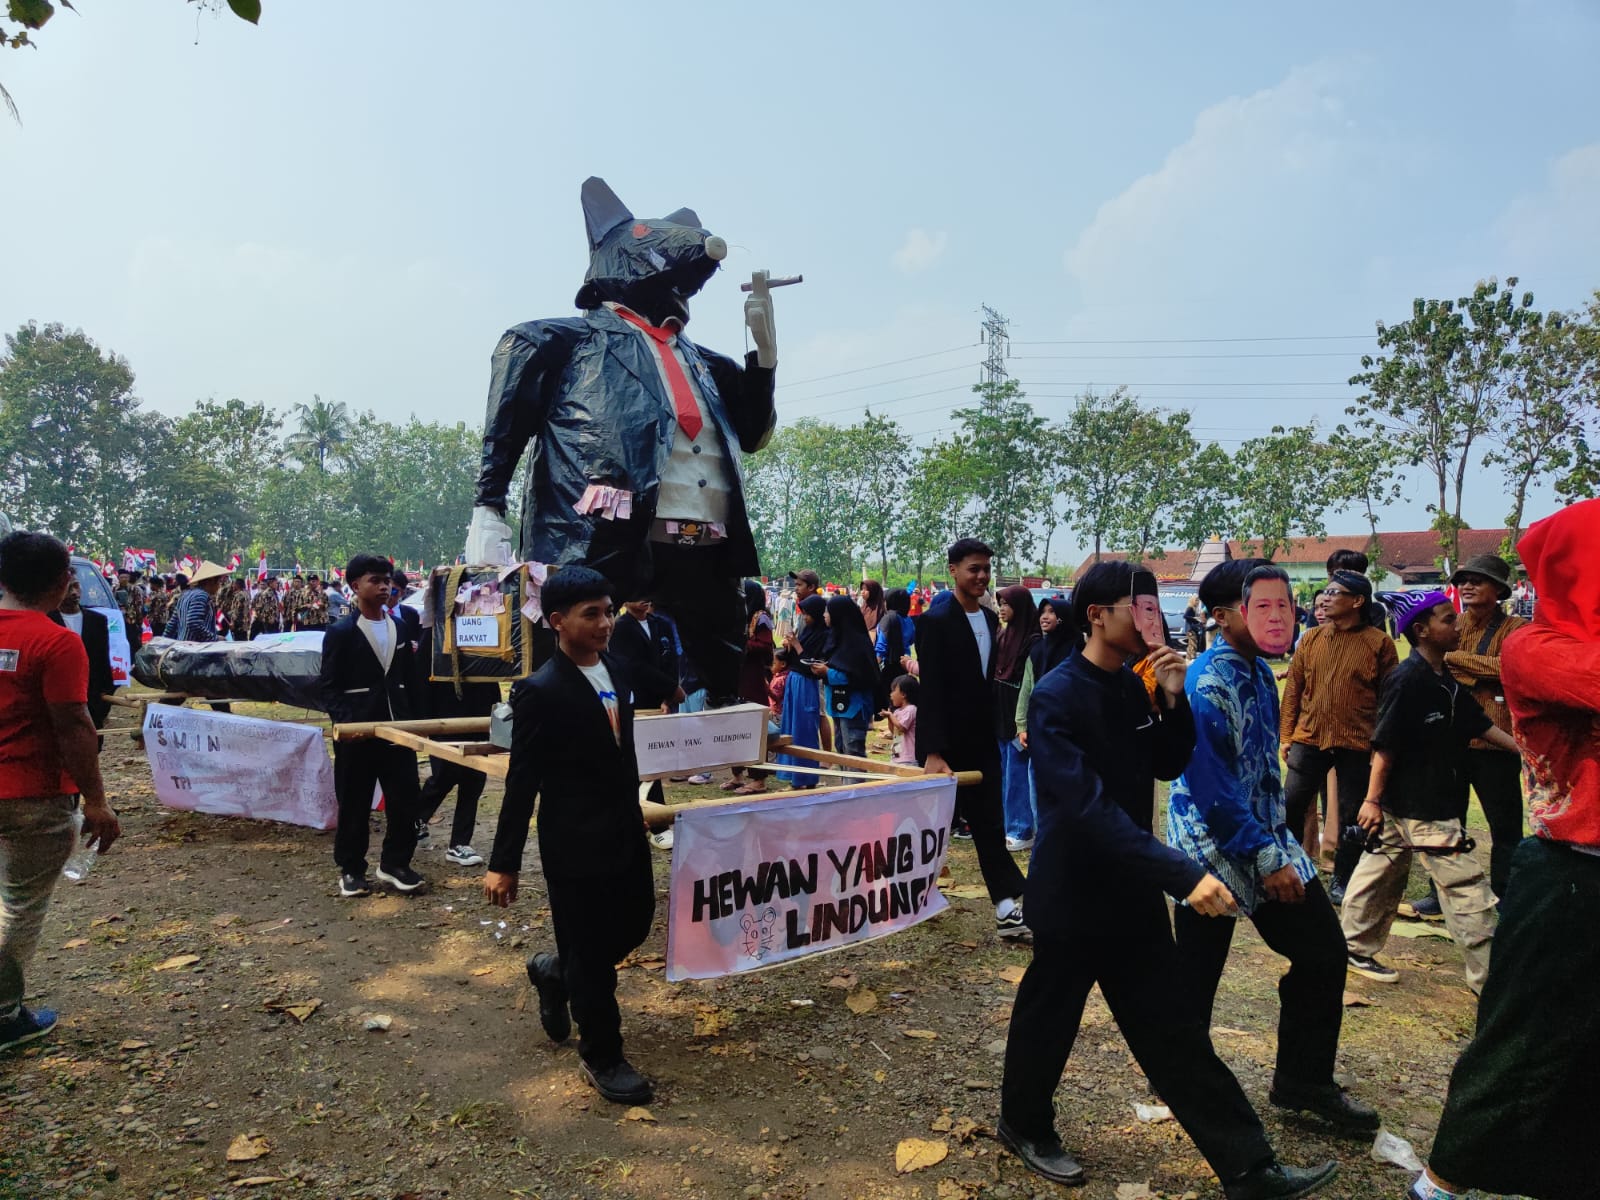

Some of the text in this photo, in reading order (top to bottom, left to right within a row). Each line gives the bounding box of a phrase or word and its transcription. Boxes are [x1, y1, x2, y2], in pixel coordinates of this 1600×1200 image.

[461, 617, 482, 626] UANG
[458, 634, 488, 643] RAKYAT
[647, 732, 753, 751] HEWAN YANG DILINDUNGI
[691, 826, 946, 923] HEWAN YANG DI
